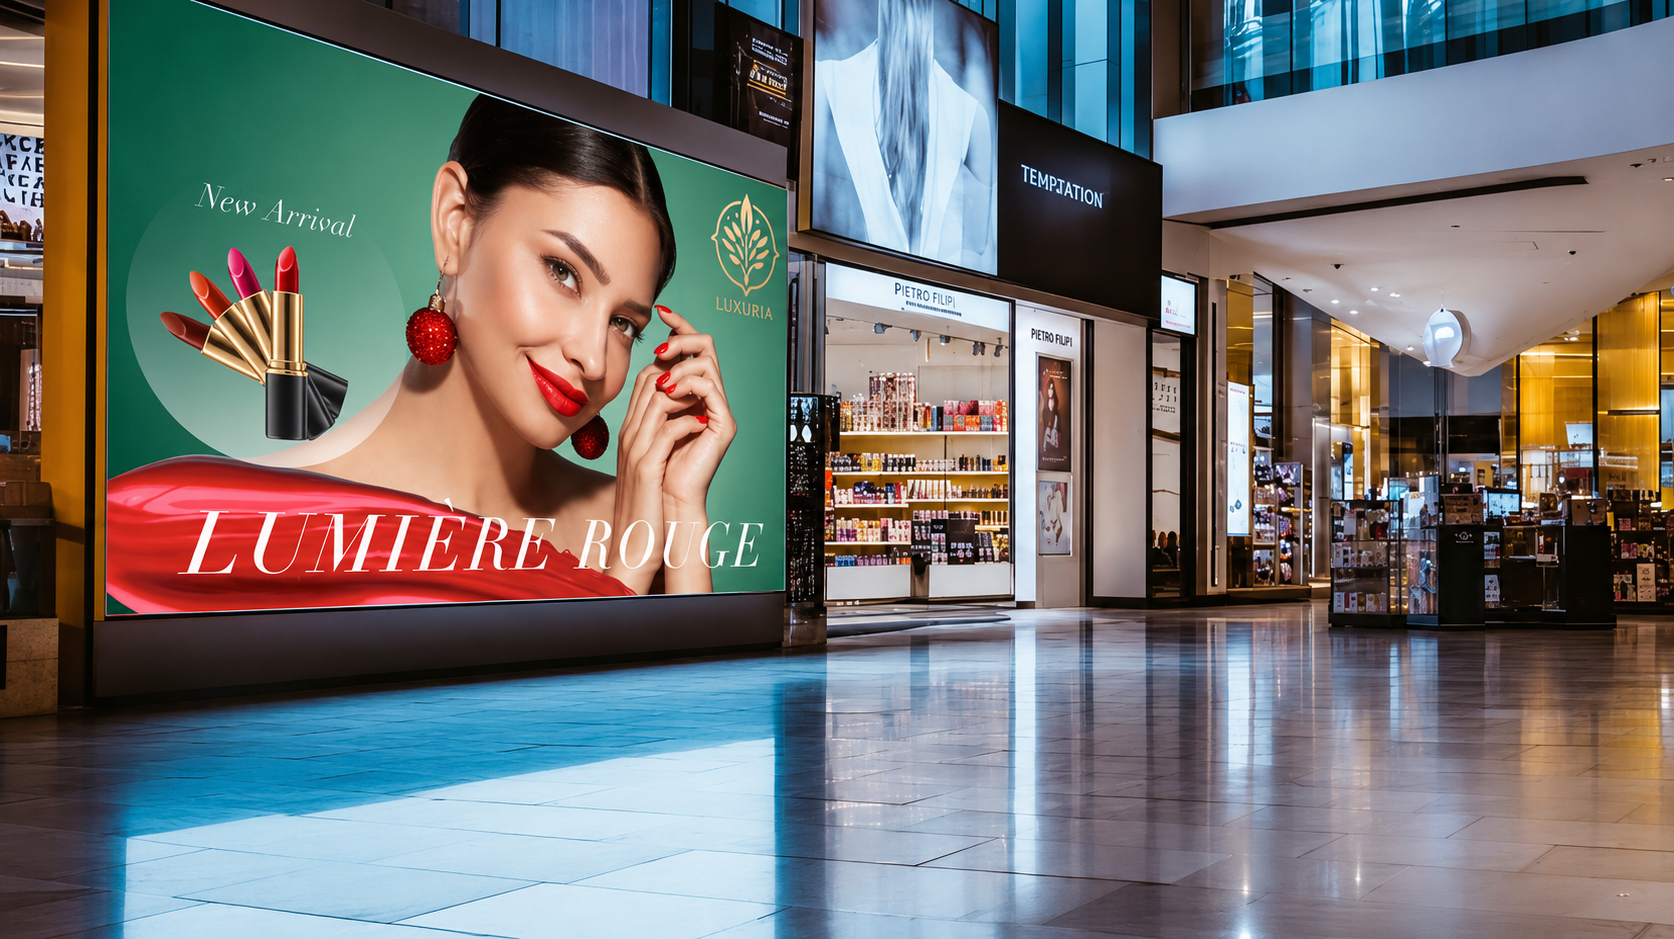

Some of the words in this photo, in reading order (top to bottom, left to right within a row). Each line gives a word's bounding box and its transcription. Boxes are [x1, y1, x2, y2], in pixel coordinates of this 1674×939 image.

[1020, 163, 1103, 209] TEMPTATION
[195, 182, 257, 216] New
[261, 199, 356, 238] Arrival
[716, 296, 773, 321] LUXURIA
[894, 282, 930, 302] PIETRO
[933, 292, 956, 308] FILIPI
[1030, 328, 1054, 343] PIETRO
[1055, 334, 1073, 347] FILIPI
[177, 497, 556, 575] LUMIÈRE
[573, 519, 764, 570] ROUGE
